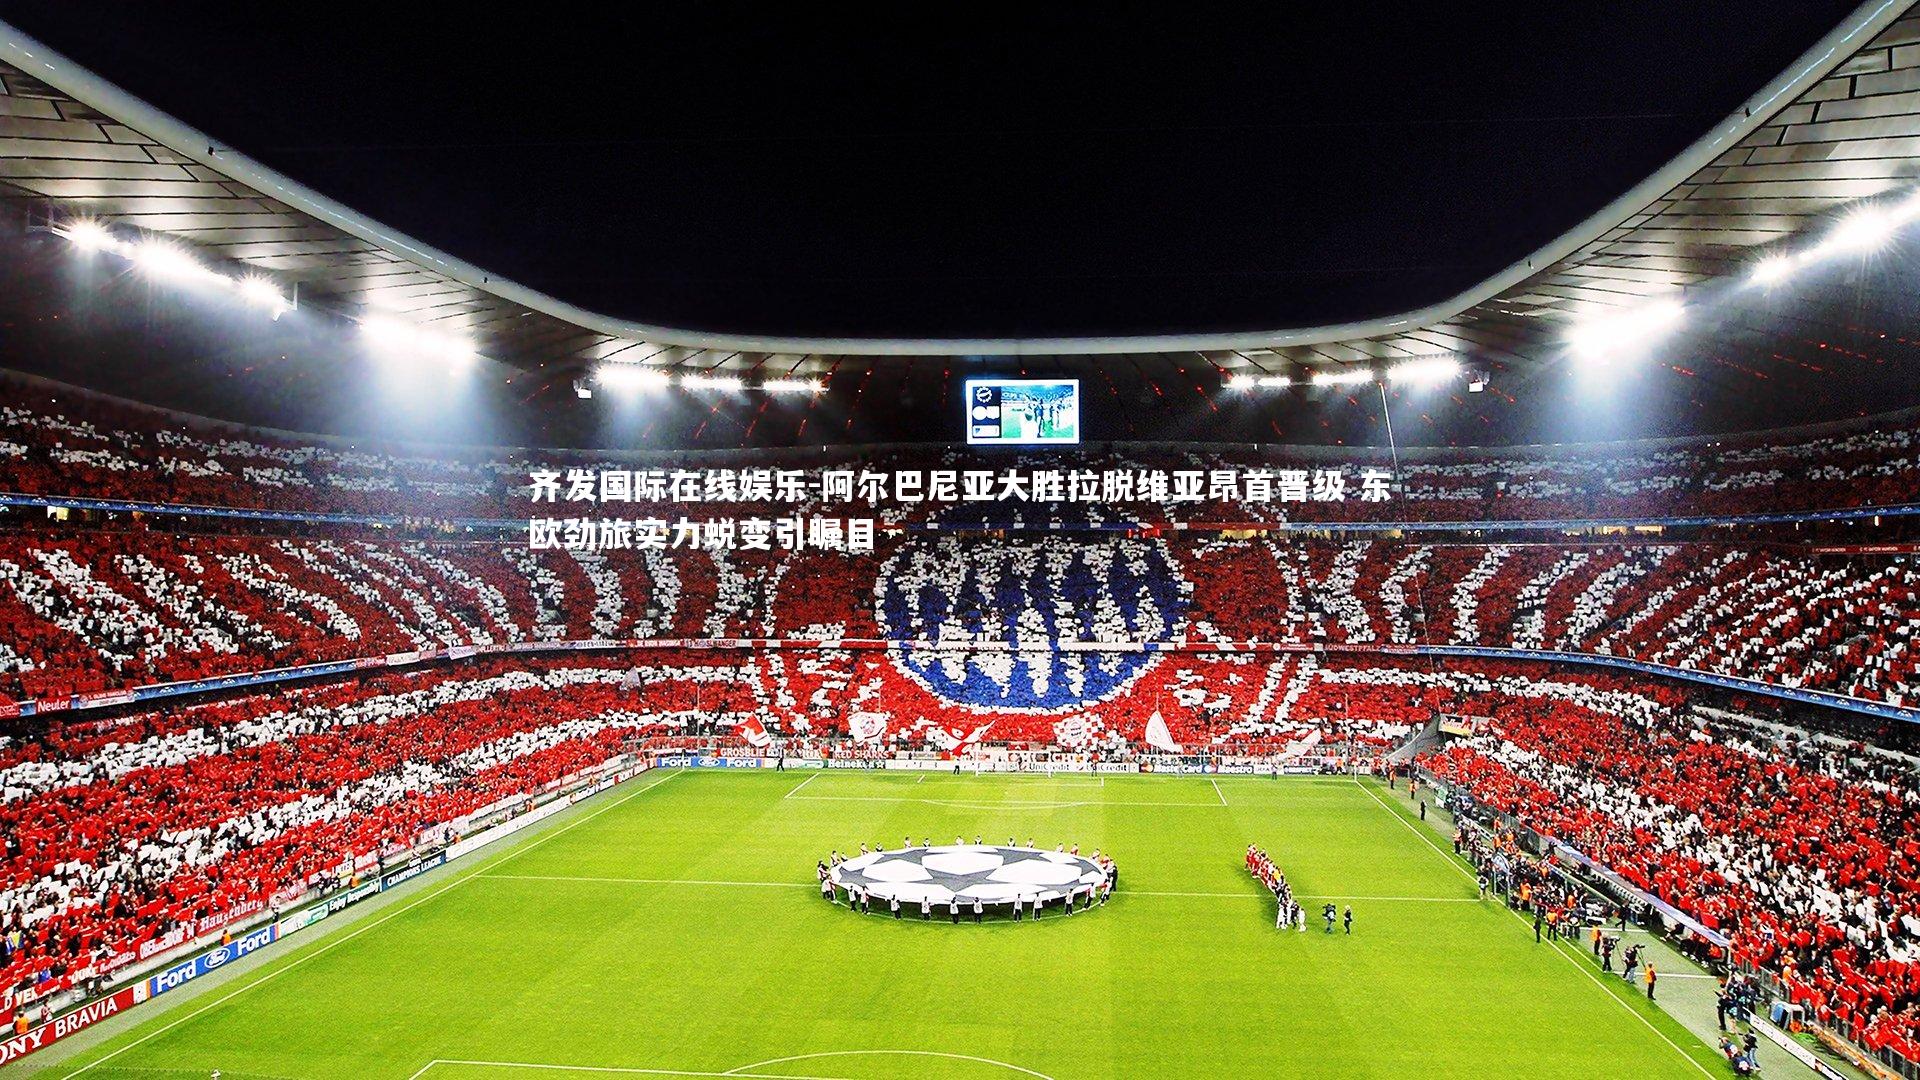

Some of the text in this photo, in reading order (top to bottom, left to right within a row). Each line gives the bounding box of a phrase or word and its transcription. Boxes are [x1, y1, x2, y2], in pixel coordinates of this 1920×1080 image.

[37, 699, 70, 713] Neuler
[661, 758, 691, 768] Ford
[727, 758, 756, 768] Ford
[1029, 763, 1070, 771] UniCedit
[1086, 763, 1127, 771] UiCredit
[387, 862, 421, 887] CHAMPIONS
[421, 855, 442, 872] LEAGUE
[329, 898, 347, 911] Enjoy
[237, 926, 271, 956] Ford
[157, 960, 196, 993] Ford
[55, 997, 117, 1038] BRAVIA
